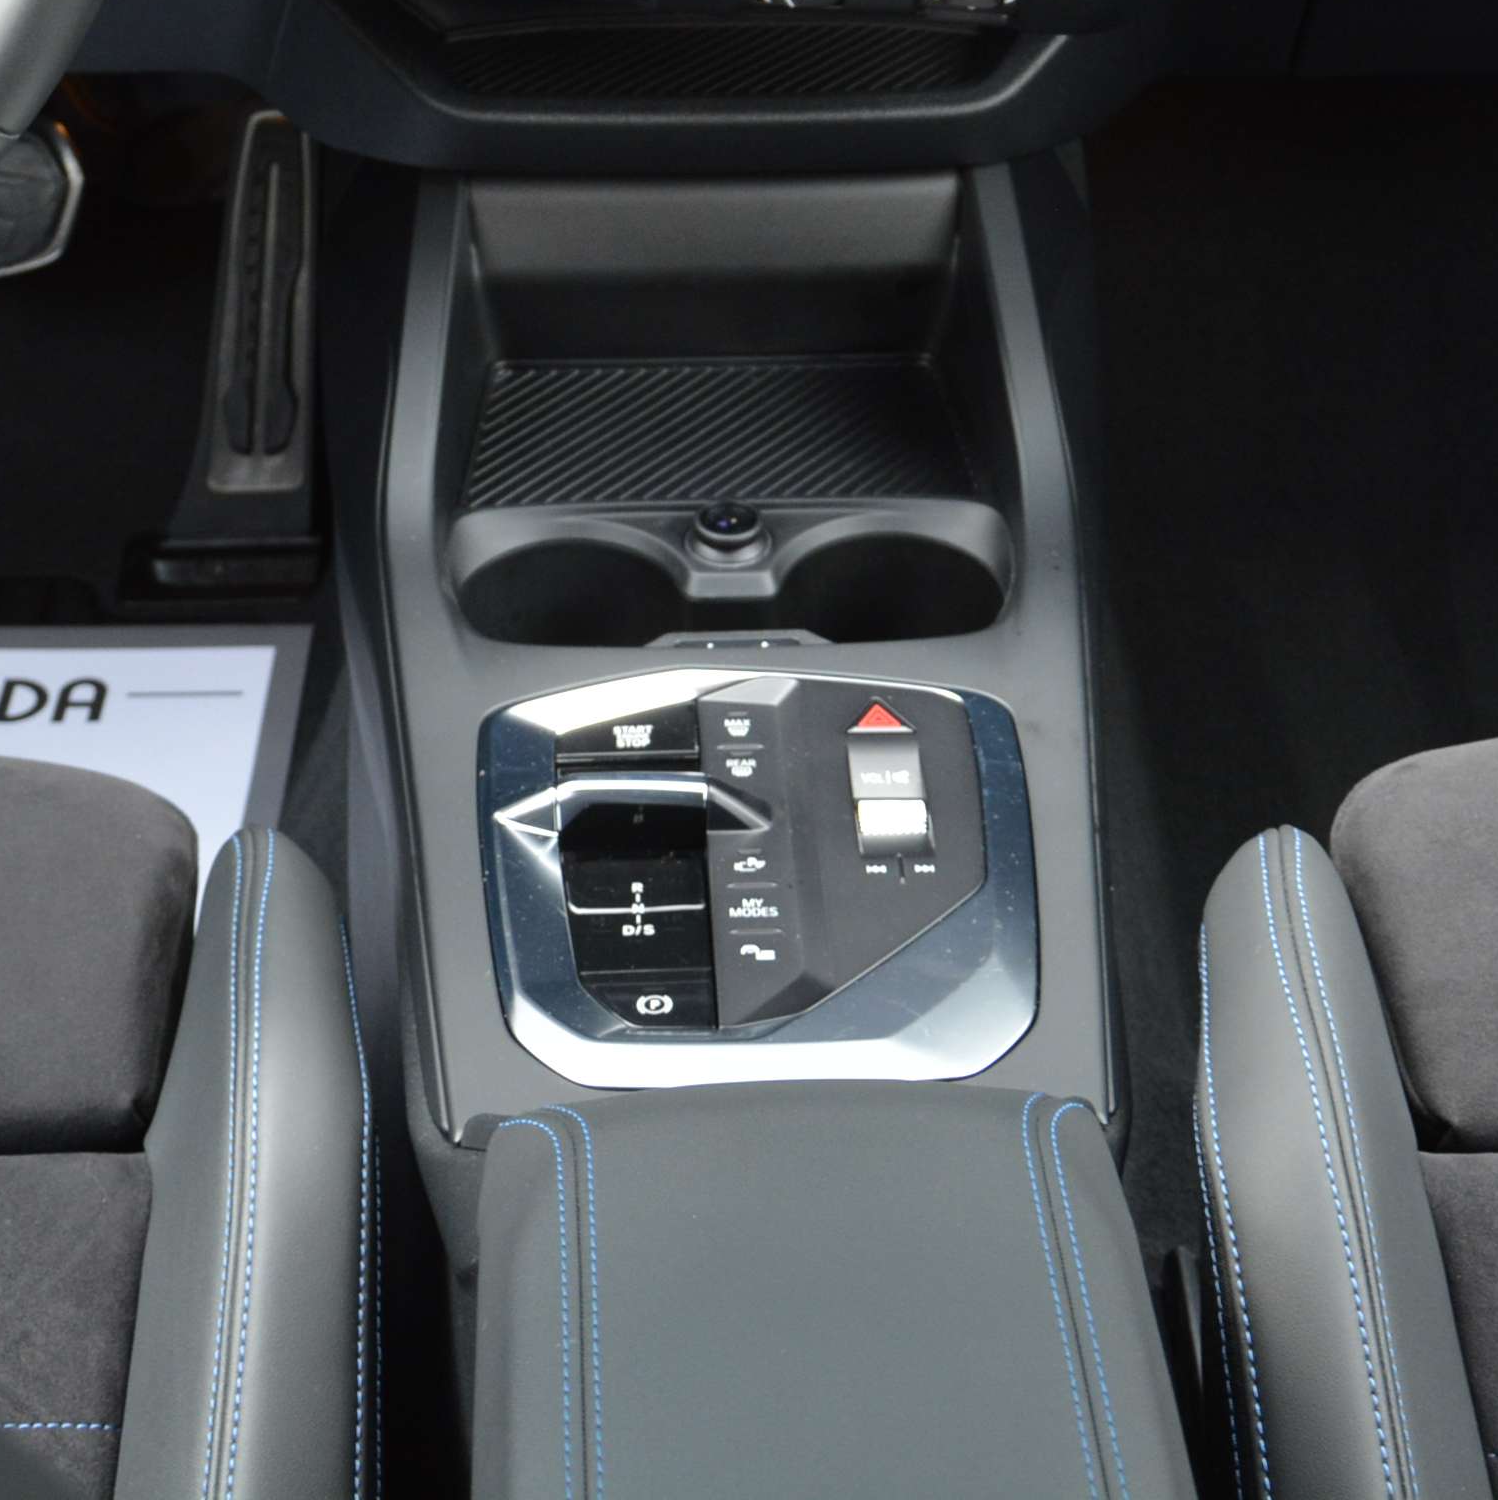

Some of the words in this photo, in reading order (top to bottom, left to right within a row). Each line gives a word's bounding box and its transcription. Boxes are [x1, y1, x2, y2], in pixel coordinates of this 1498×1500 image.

[613, 724, 653, 736] START
[616, 737, 651, 749] STOP
[740, 898, 764, 908] MY
[728, 906, 779, 918] MODES
[622, 924, 656, 937] D/S
